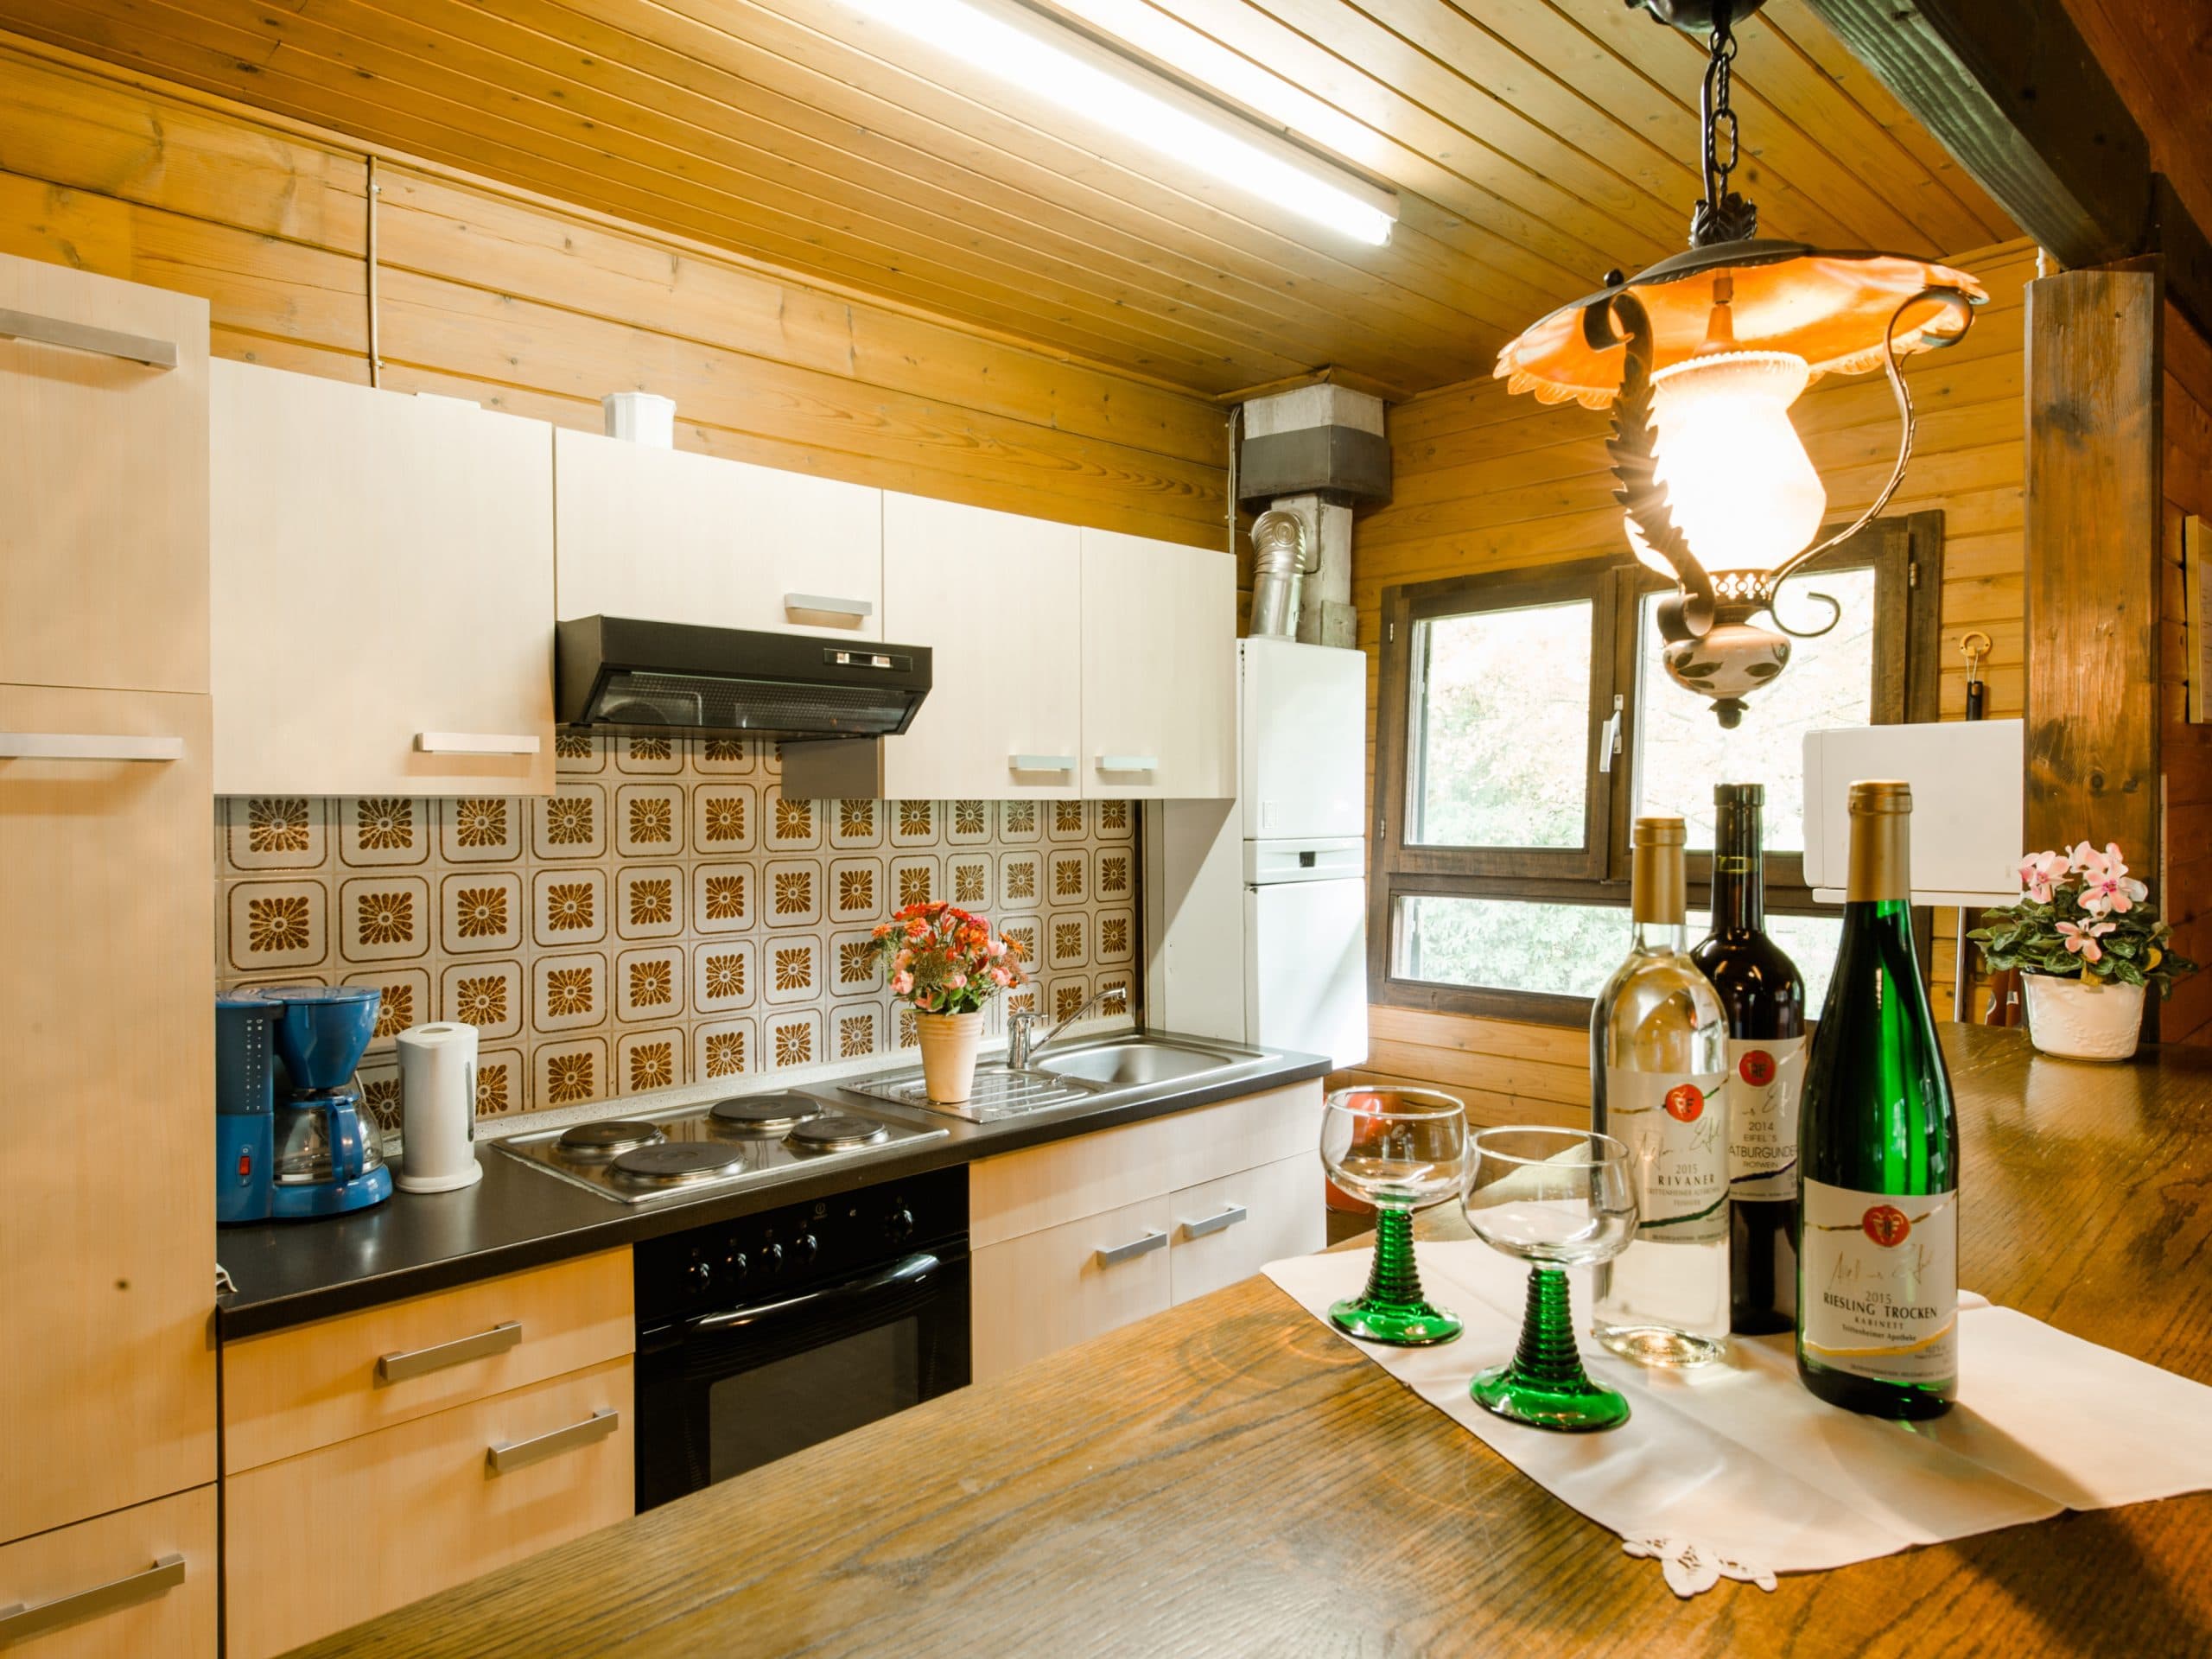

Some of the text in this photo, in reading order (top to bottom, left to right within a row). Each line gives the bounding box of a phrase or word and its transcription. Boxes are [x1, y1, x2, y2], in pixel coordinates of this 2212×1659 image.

[1748, 1122, 1774, 1132] 2014
[1675, 1164, 1699, 1174] 2015
[1658, 1173, 1715, 1186] RIVANER
[1866, 1291, 1891, 1304] 2015
[1823, 1293, 1937, 1319] RIESLING TROCKEN
[1854, 1317, 1904, 1330] KABINETT
